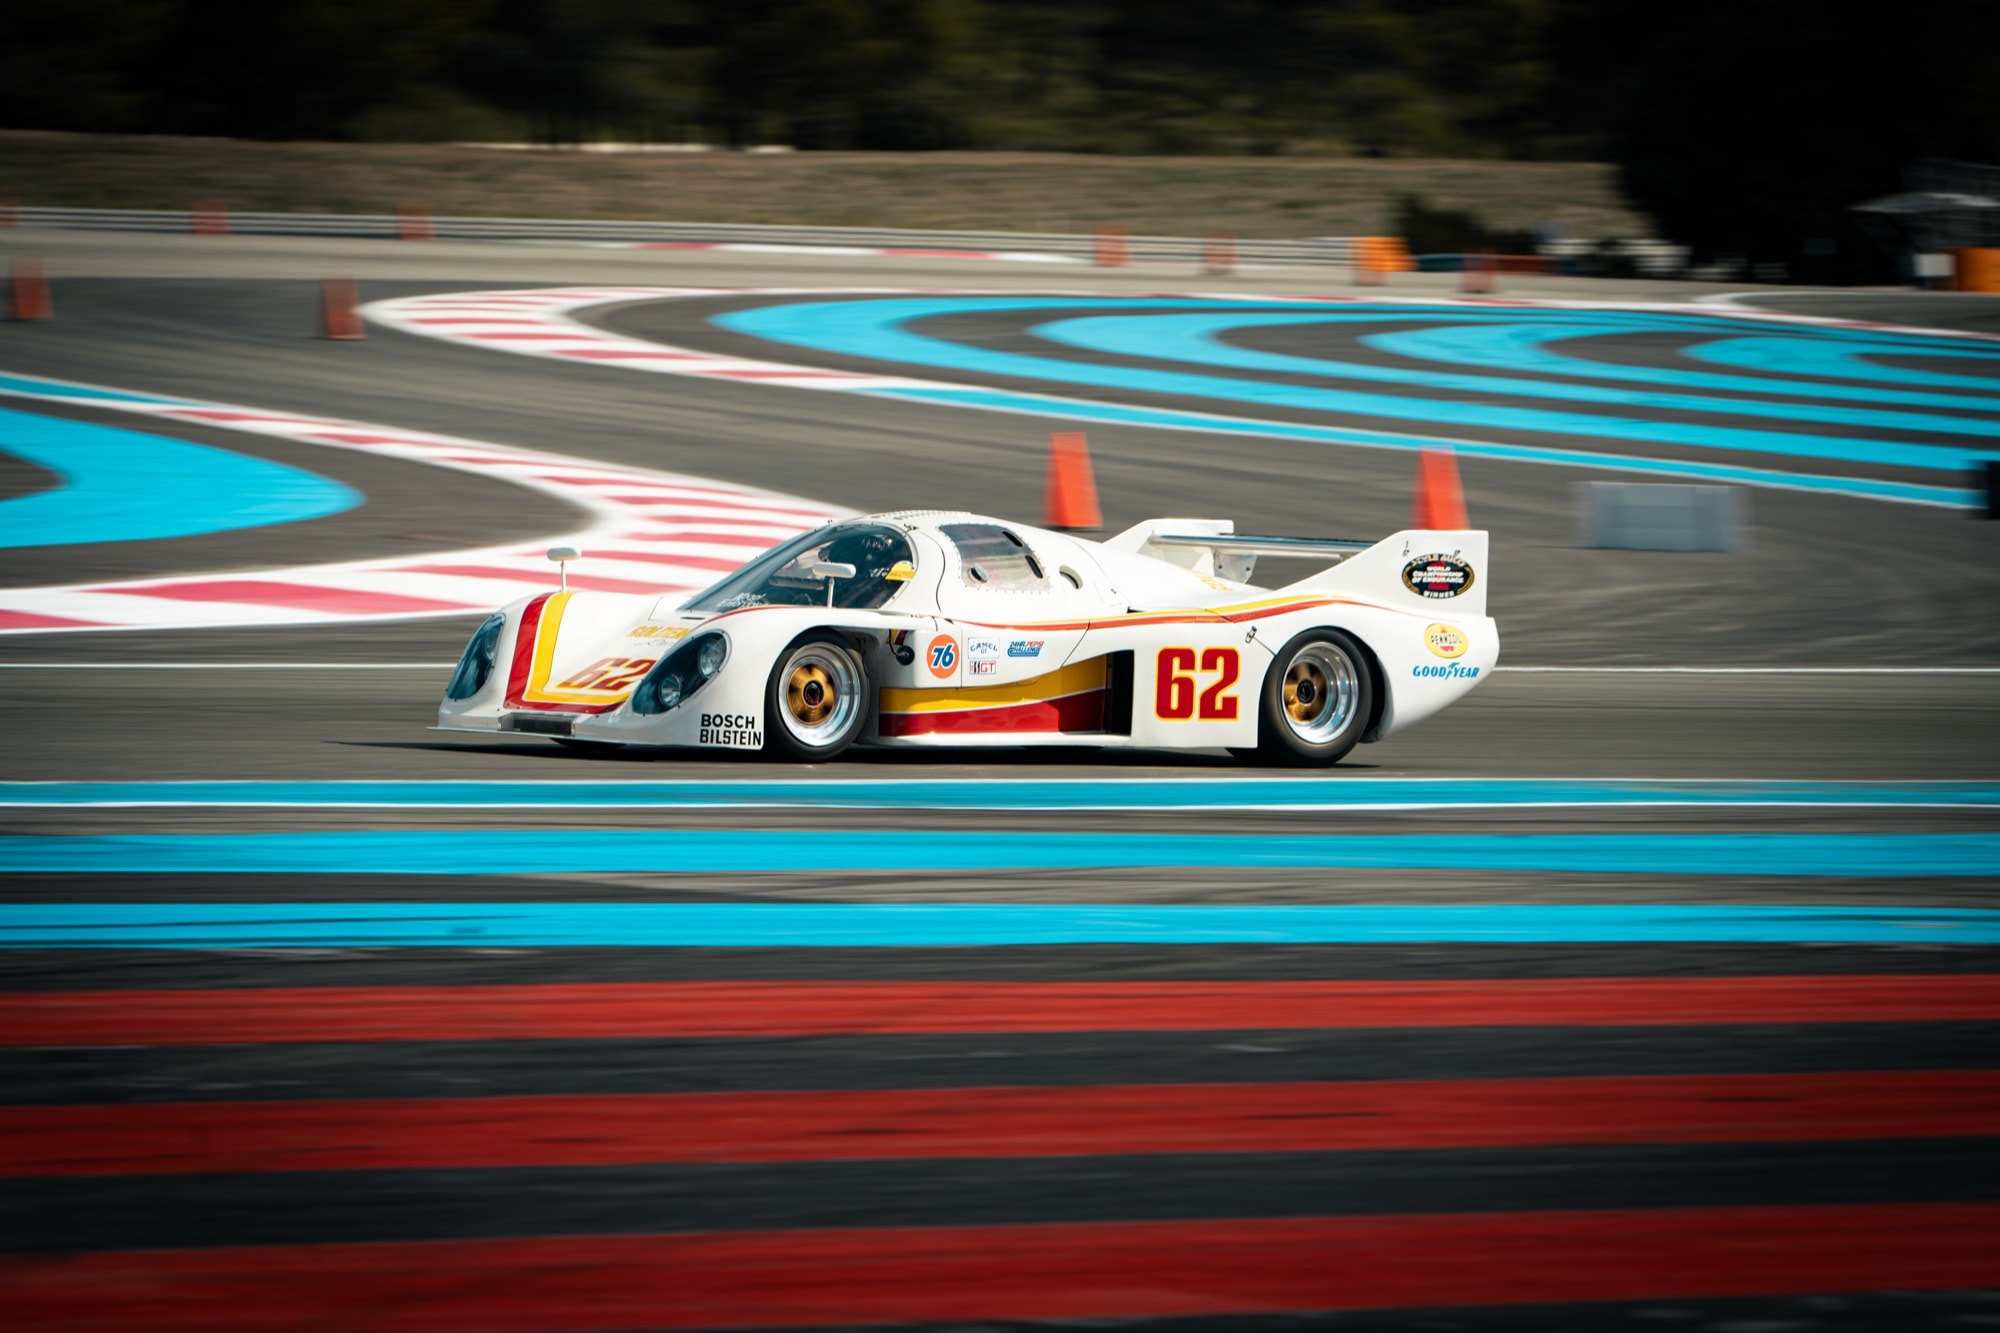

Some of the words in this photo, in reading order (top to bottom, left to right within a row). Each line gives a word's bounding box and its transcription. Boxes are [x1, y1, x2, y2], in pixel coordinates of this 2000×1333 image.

[1423, 590, 1455, 599] WINNER
[931, 643, 955, 668] 76
[970, 642, 998, 652] CAMEL
[556, 657, 658, 691] 62
[981, 662, 995, 673] GT
[1412, 661, 1480, 680] GOODYEAR
[1155, 647, 1240, 721] 62
[701, 714, 755, 729] BOSCH
[700, 728, 762, 746] BILSTEIN
